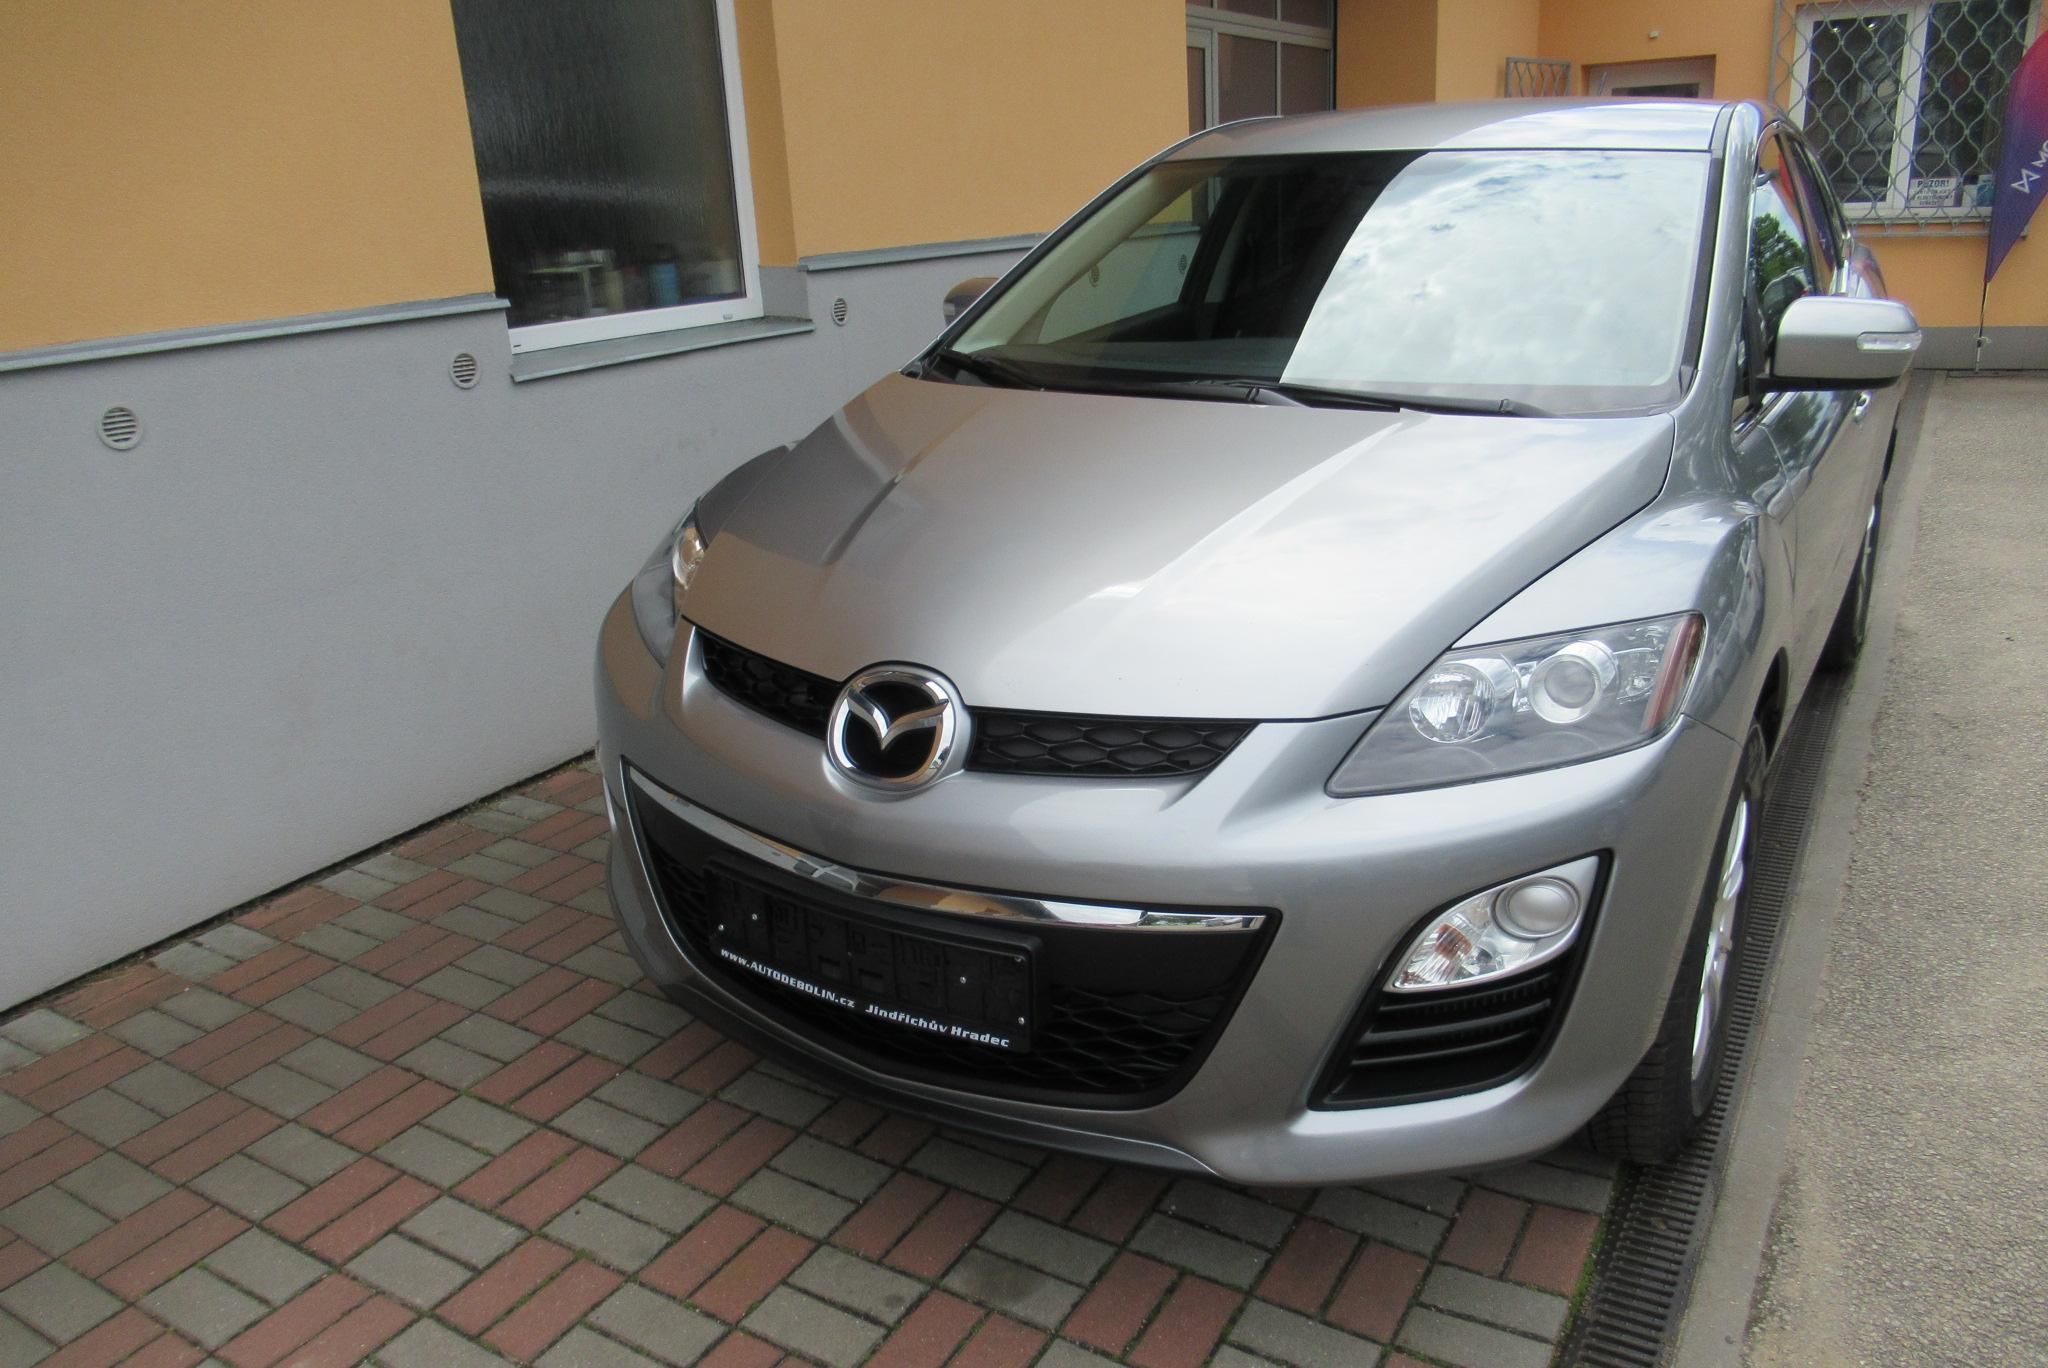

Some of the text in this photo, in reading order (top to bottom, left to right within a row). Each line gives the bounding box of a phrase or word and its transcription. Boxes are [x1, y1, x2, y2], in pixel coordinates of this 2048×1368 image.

[720, 948, 1010, 1048] www.AUTODEBOLIN.cz Jindřichův Hradec
